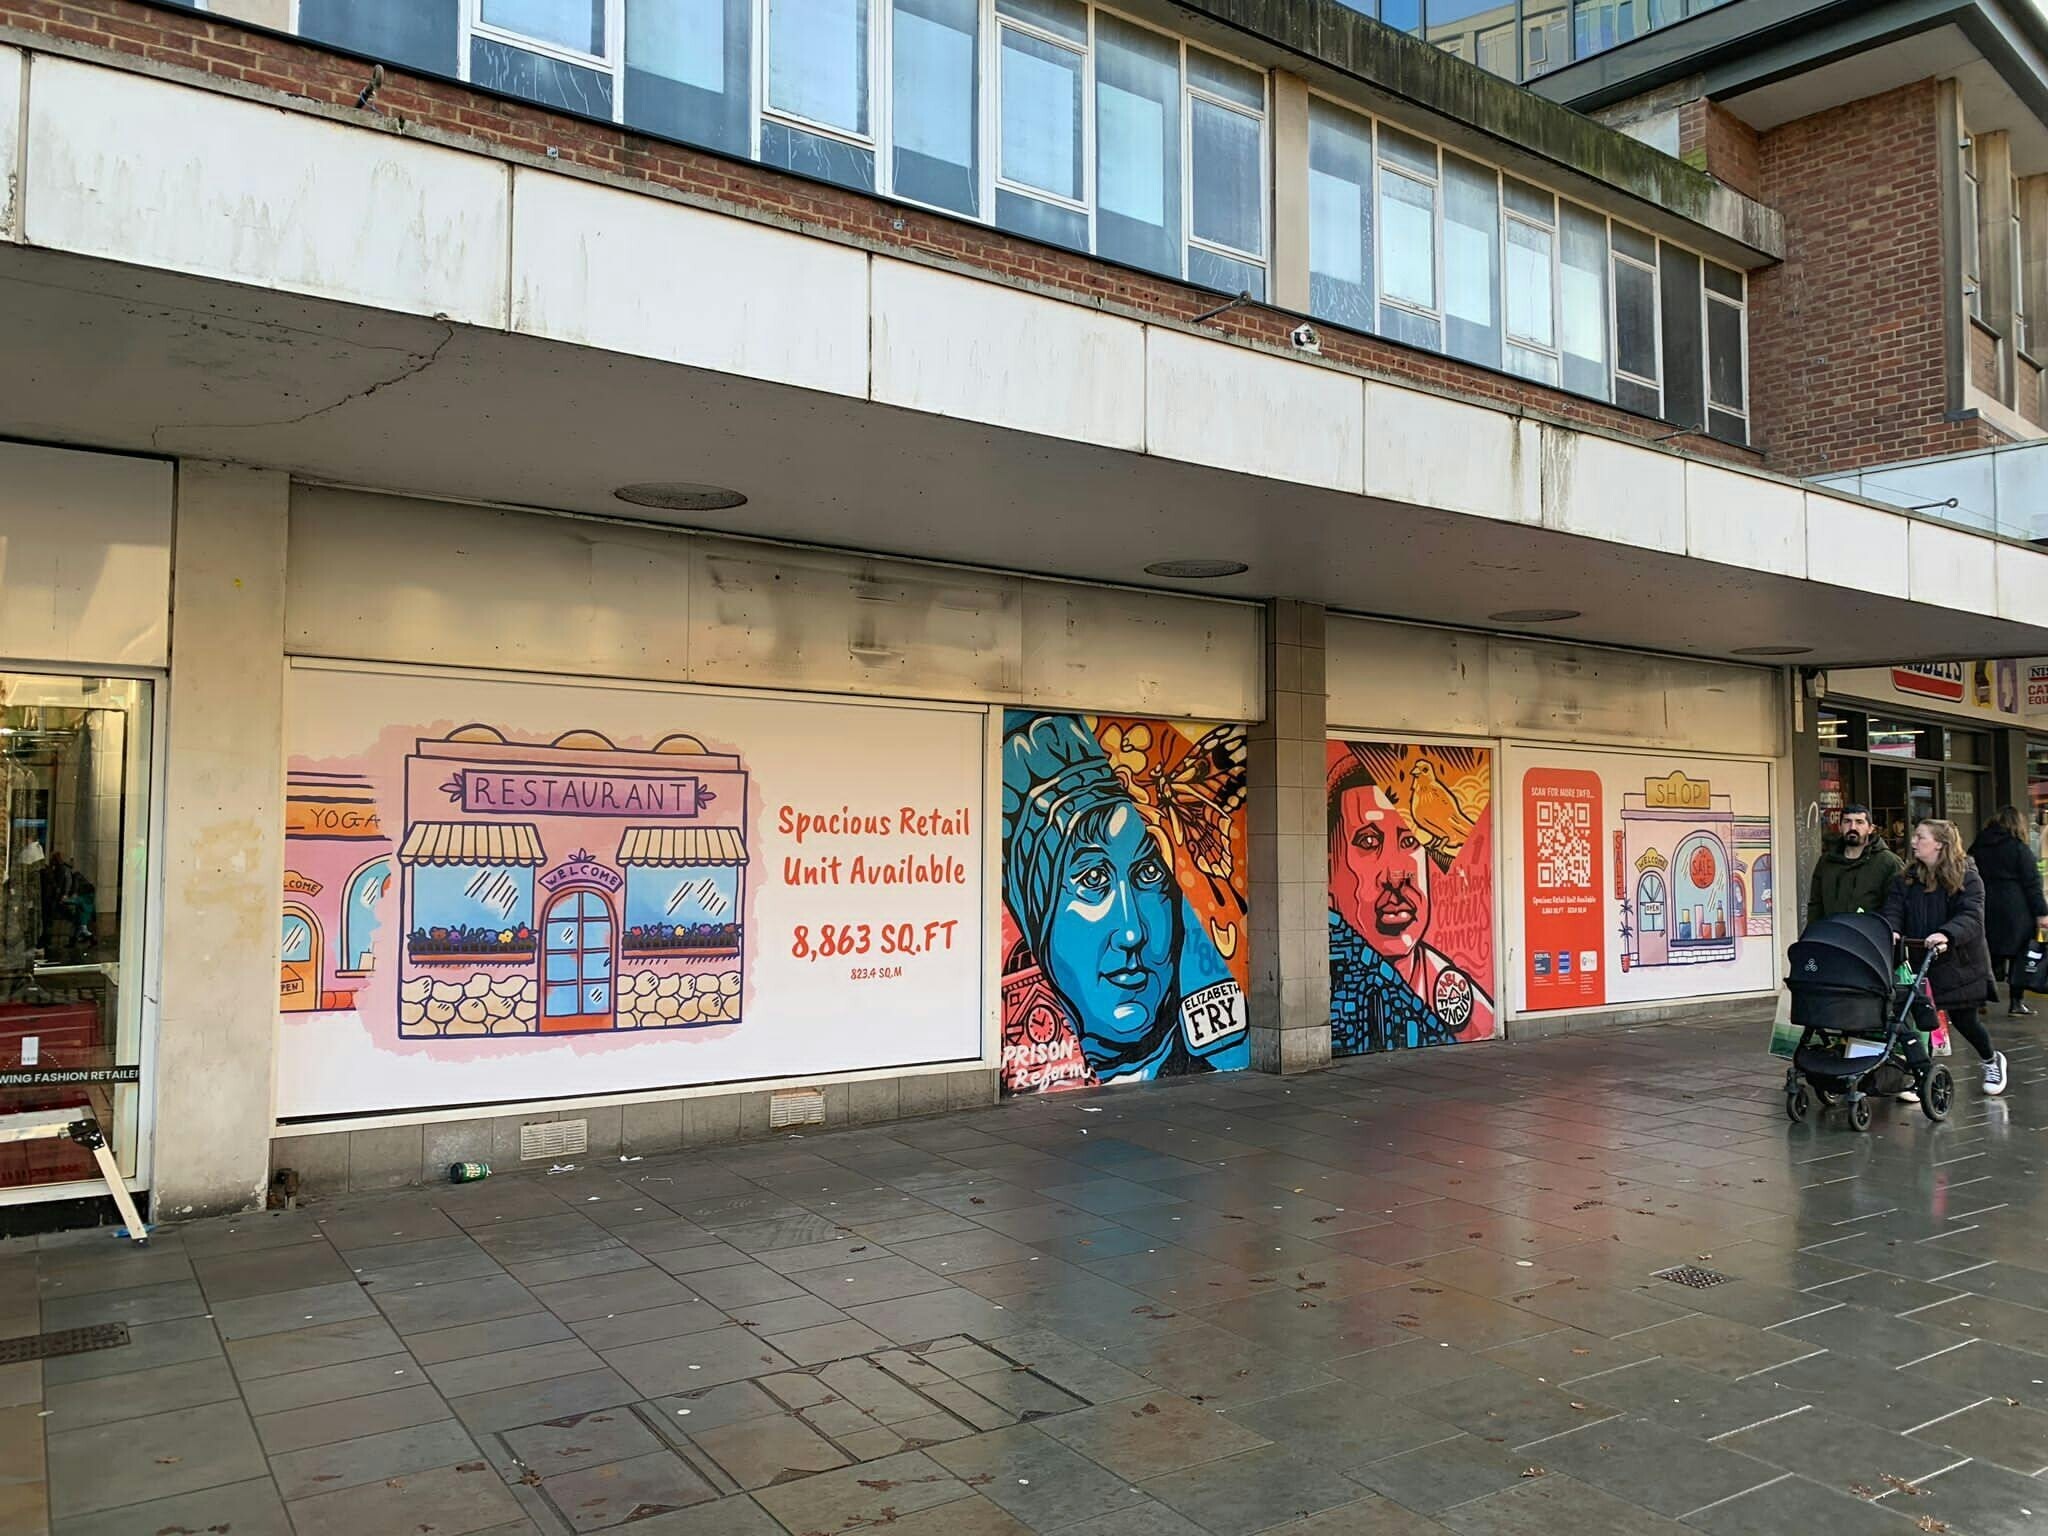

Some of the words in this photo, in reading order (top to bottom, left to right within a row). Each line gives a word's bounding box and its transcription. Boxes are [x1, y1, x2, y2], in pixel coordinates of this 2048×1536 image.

[474, 777, 686, 811] RESTAURANT
[1655, 783, 1703, 804] SHOP
[310, 808, 381, 828] YOGA
[777, 805, 891, 844] Spacious
[900, 807, 969, 836] Retail
[545, 865, 618, 886] WELCOME
[783, 856, 842, 885] Unit
[850, 854, 966, 884] Available
[1638, 855, 1665, 868] WELCOME
[792, 924, 871, 962] 8,863
[880, 920, 958, 955] SQ.FT
[850, 967, 876, 980] 823.4
[879, 966, 902, 979] SQ.M
[1437, 973, 1466, 997] PABLO
[1184, 983, 1241, 1010] ELIZABETH
[1438, 990, 1470, 1024] FANQUE
[1188, 996, 1238, 1041] FRY
[1001, 1038, 1074, 1069] PRISON
[34, 1071, 88, 1083] FASHION
[1014, 1060, 1092, 1091] Reform
